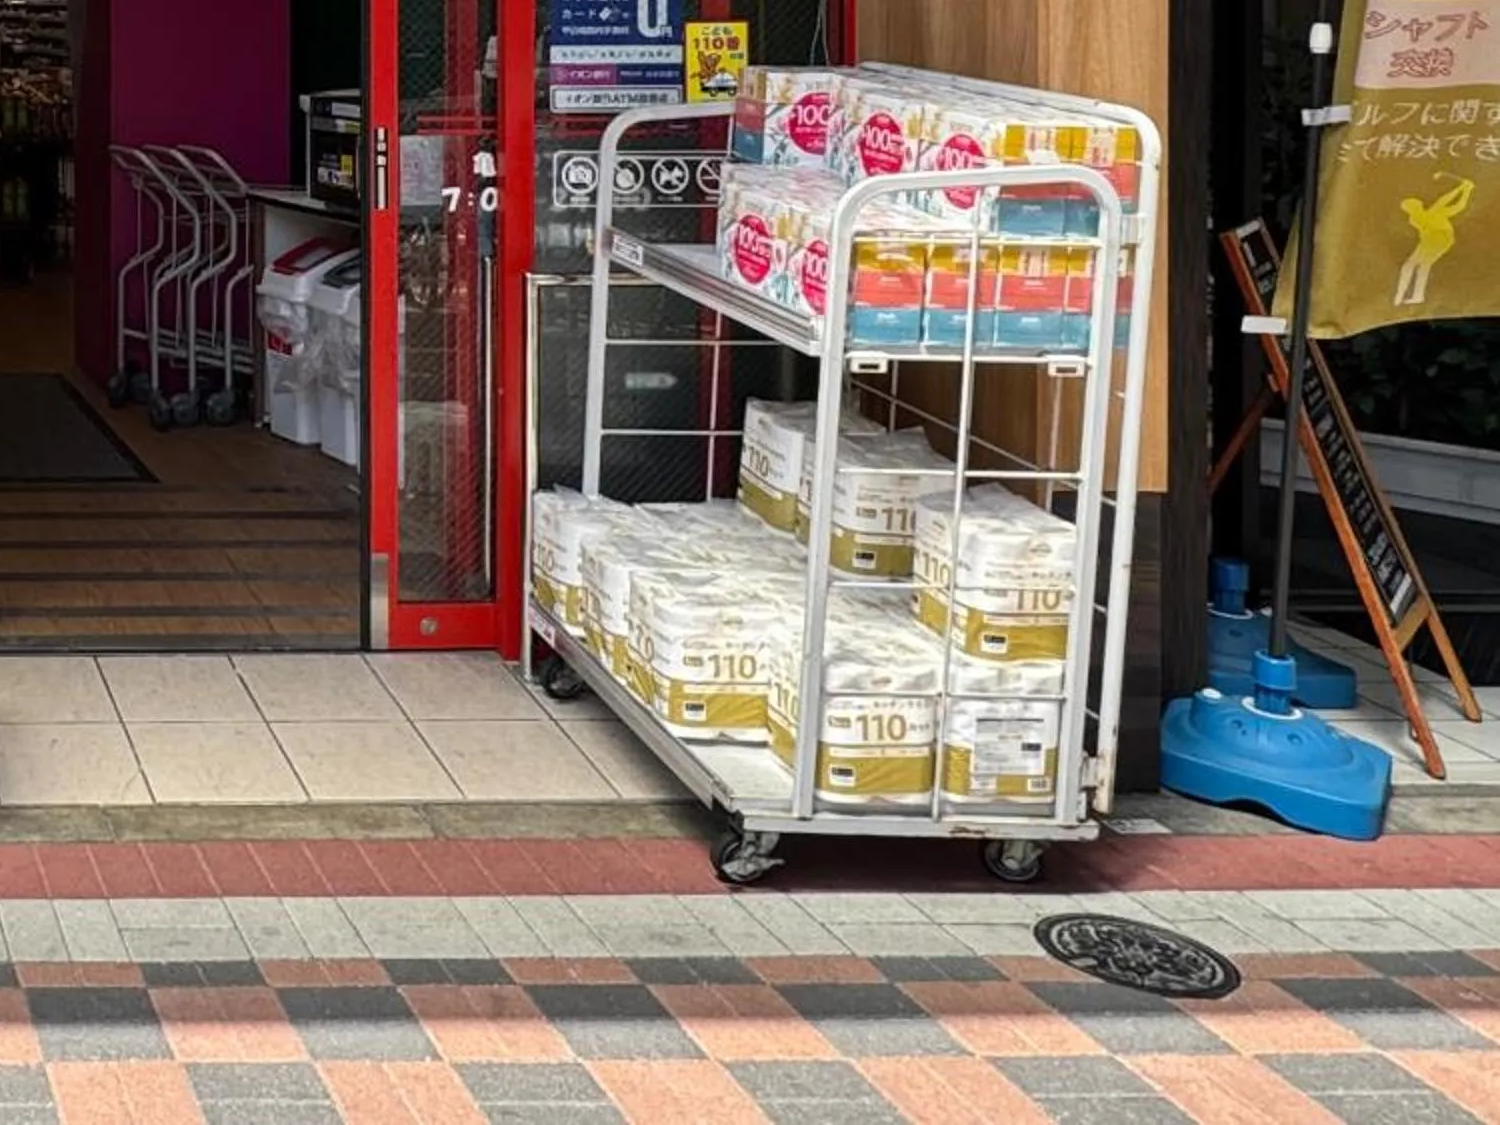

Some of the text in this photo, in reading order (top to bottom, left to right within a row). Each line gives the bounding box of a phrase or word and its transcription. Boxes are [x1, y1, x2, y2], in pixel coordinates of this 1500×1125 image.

[1364, 10, 1490, 42] シャフト
[1387, 47, 1454, 78] 交換
[1353, 98, 1500, 126] ルフに関す
[707, 654, 757, 679] 110
[855, 714, 907, 741] 110
